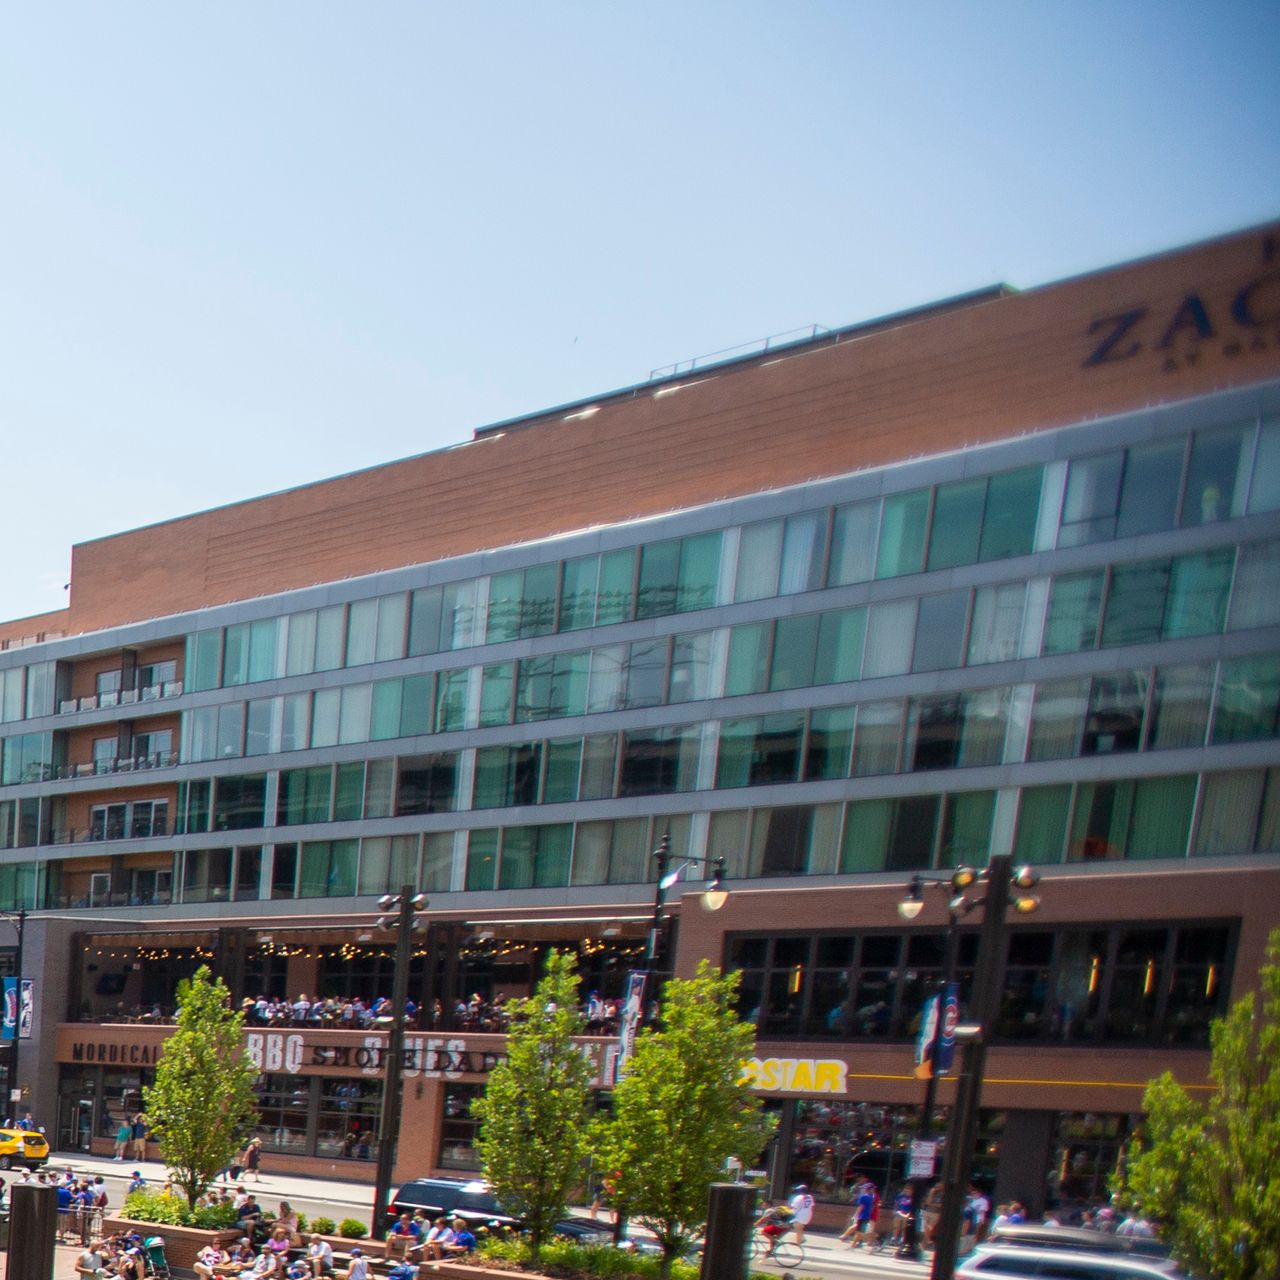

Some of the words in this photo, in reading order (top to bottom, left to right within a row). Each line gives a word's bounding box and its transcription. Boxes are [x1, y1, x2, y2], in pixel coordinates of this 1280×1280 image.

[72, 1042, 157, 1064] MORDECAI
[247, 1033, 305, 1074] BBQ
[362, 1036, 467, 1079] BUES
